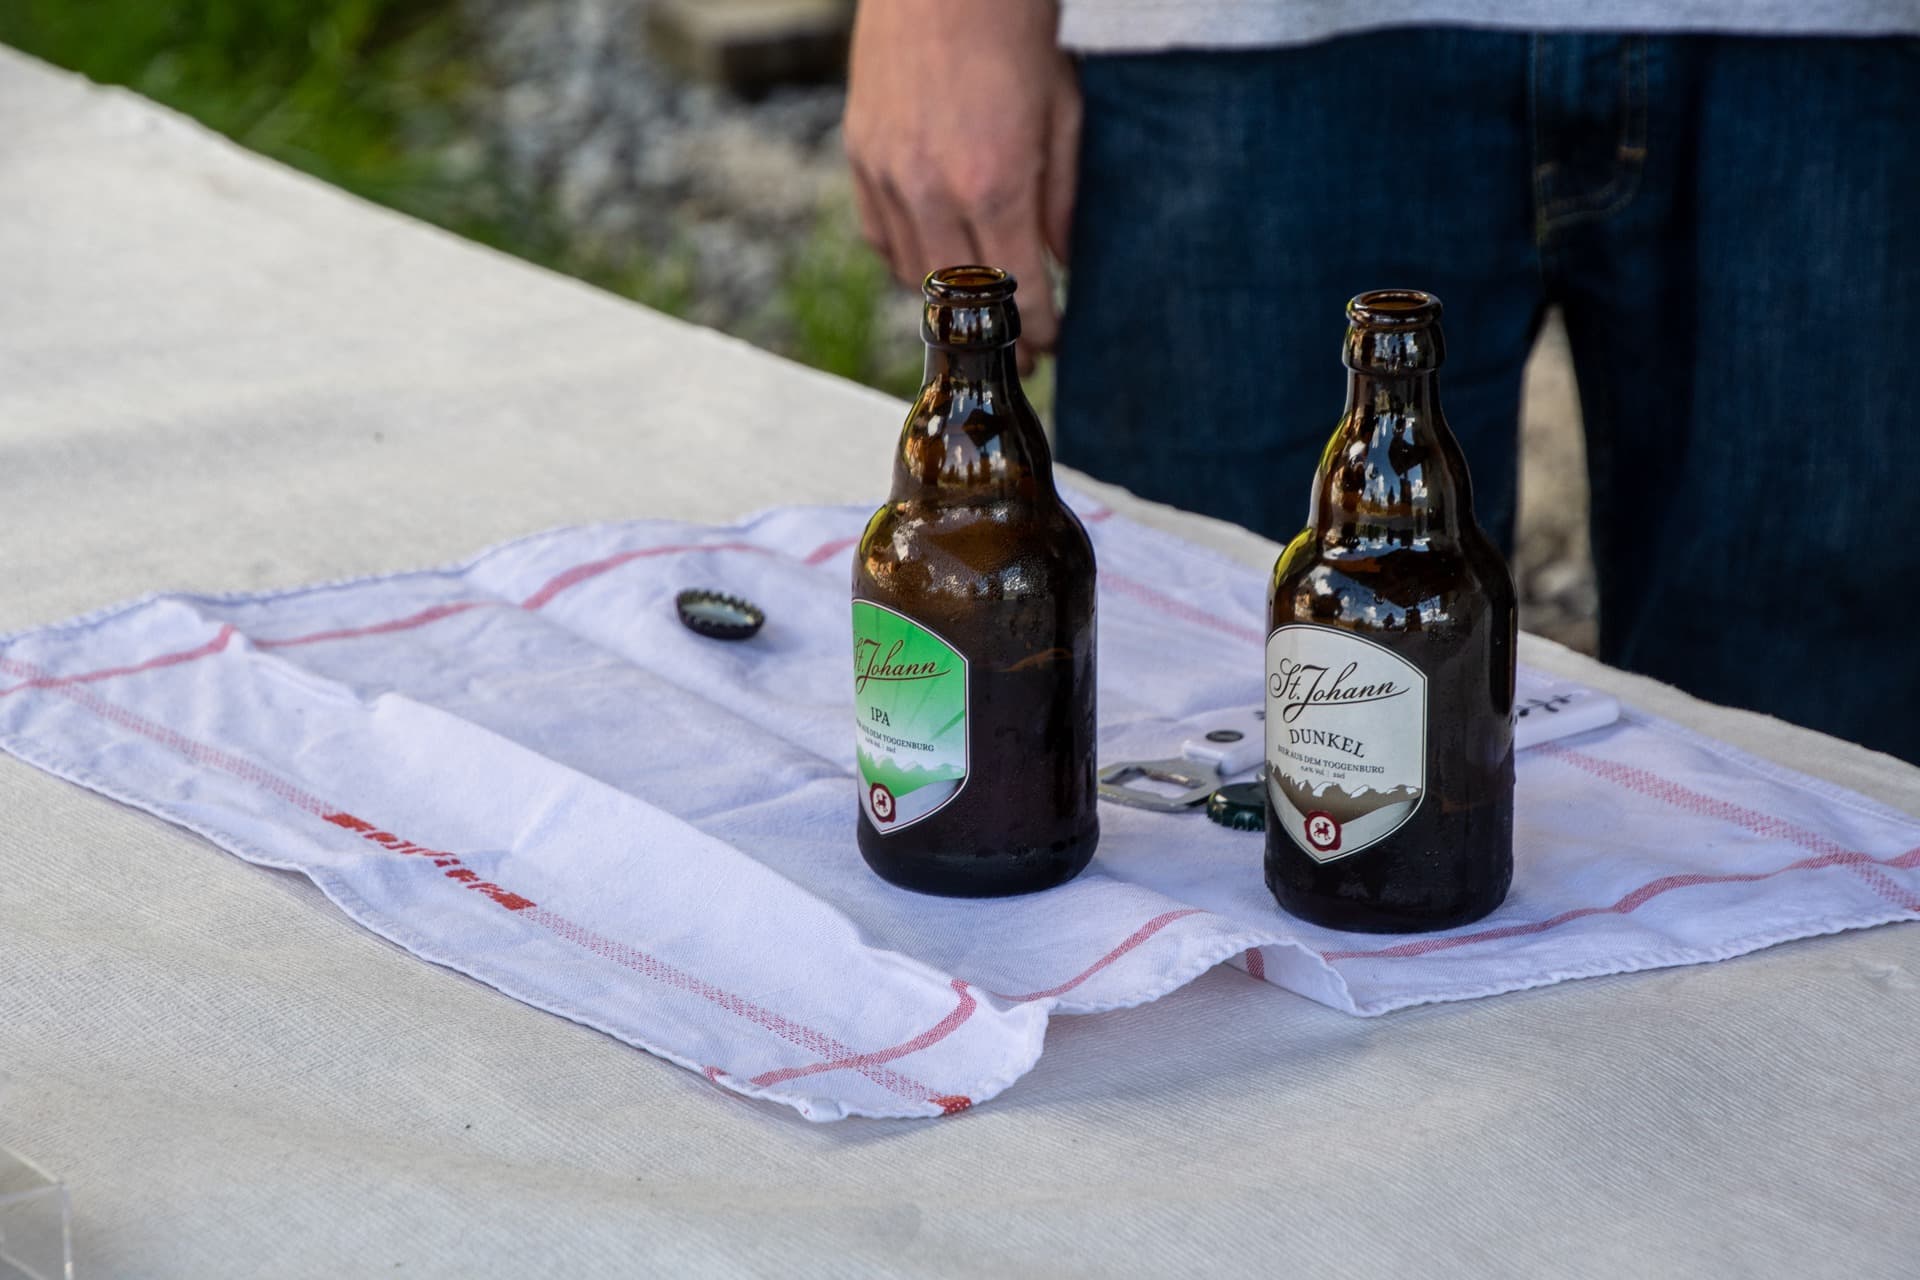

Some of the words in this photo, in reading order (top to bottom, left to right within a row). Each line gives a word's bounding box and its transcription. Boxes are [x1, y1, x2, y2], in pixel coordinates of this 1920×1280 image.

[856, 639, 951, 695] Johann
[1269, 657, 1301, 700] St.
[1283, 661, 1411, 724] Johann
[871, 707, 890, 727] IPA
[883, 734, 935, 752] TOGGENBURG
[1289, 729, 1365, 758] DUNKEL
[1304, 755, 1321, 766] DEM
[1323, 759, 1385, 775] TOGGENBURG
